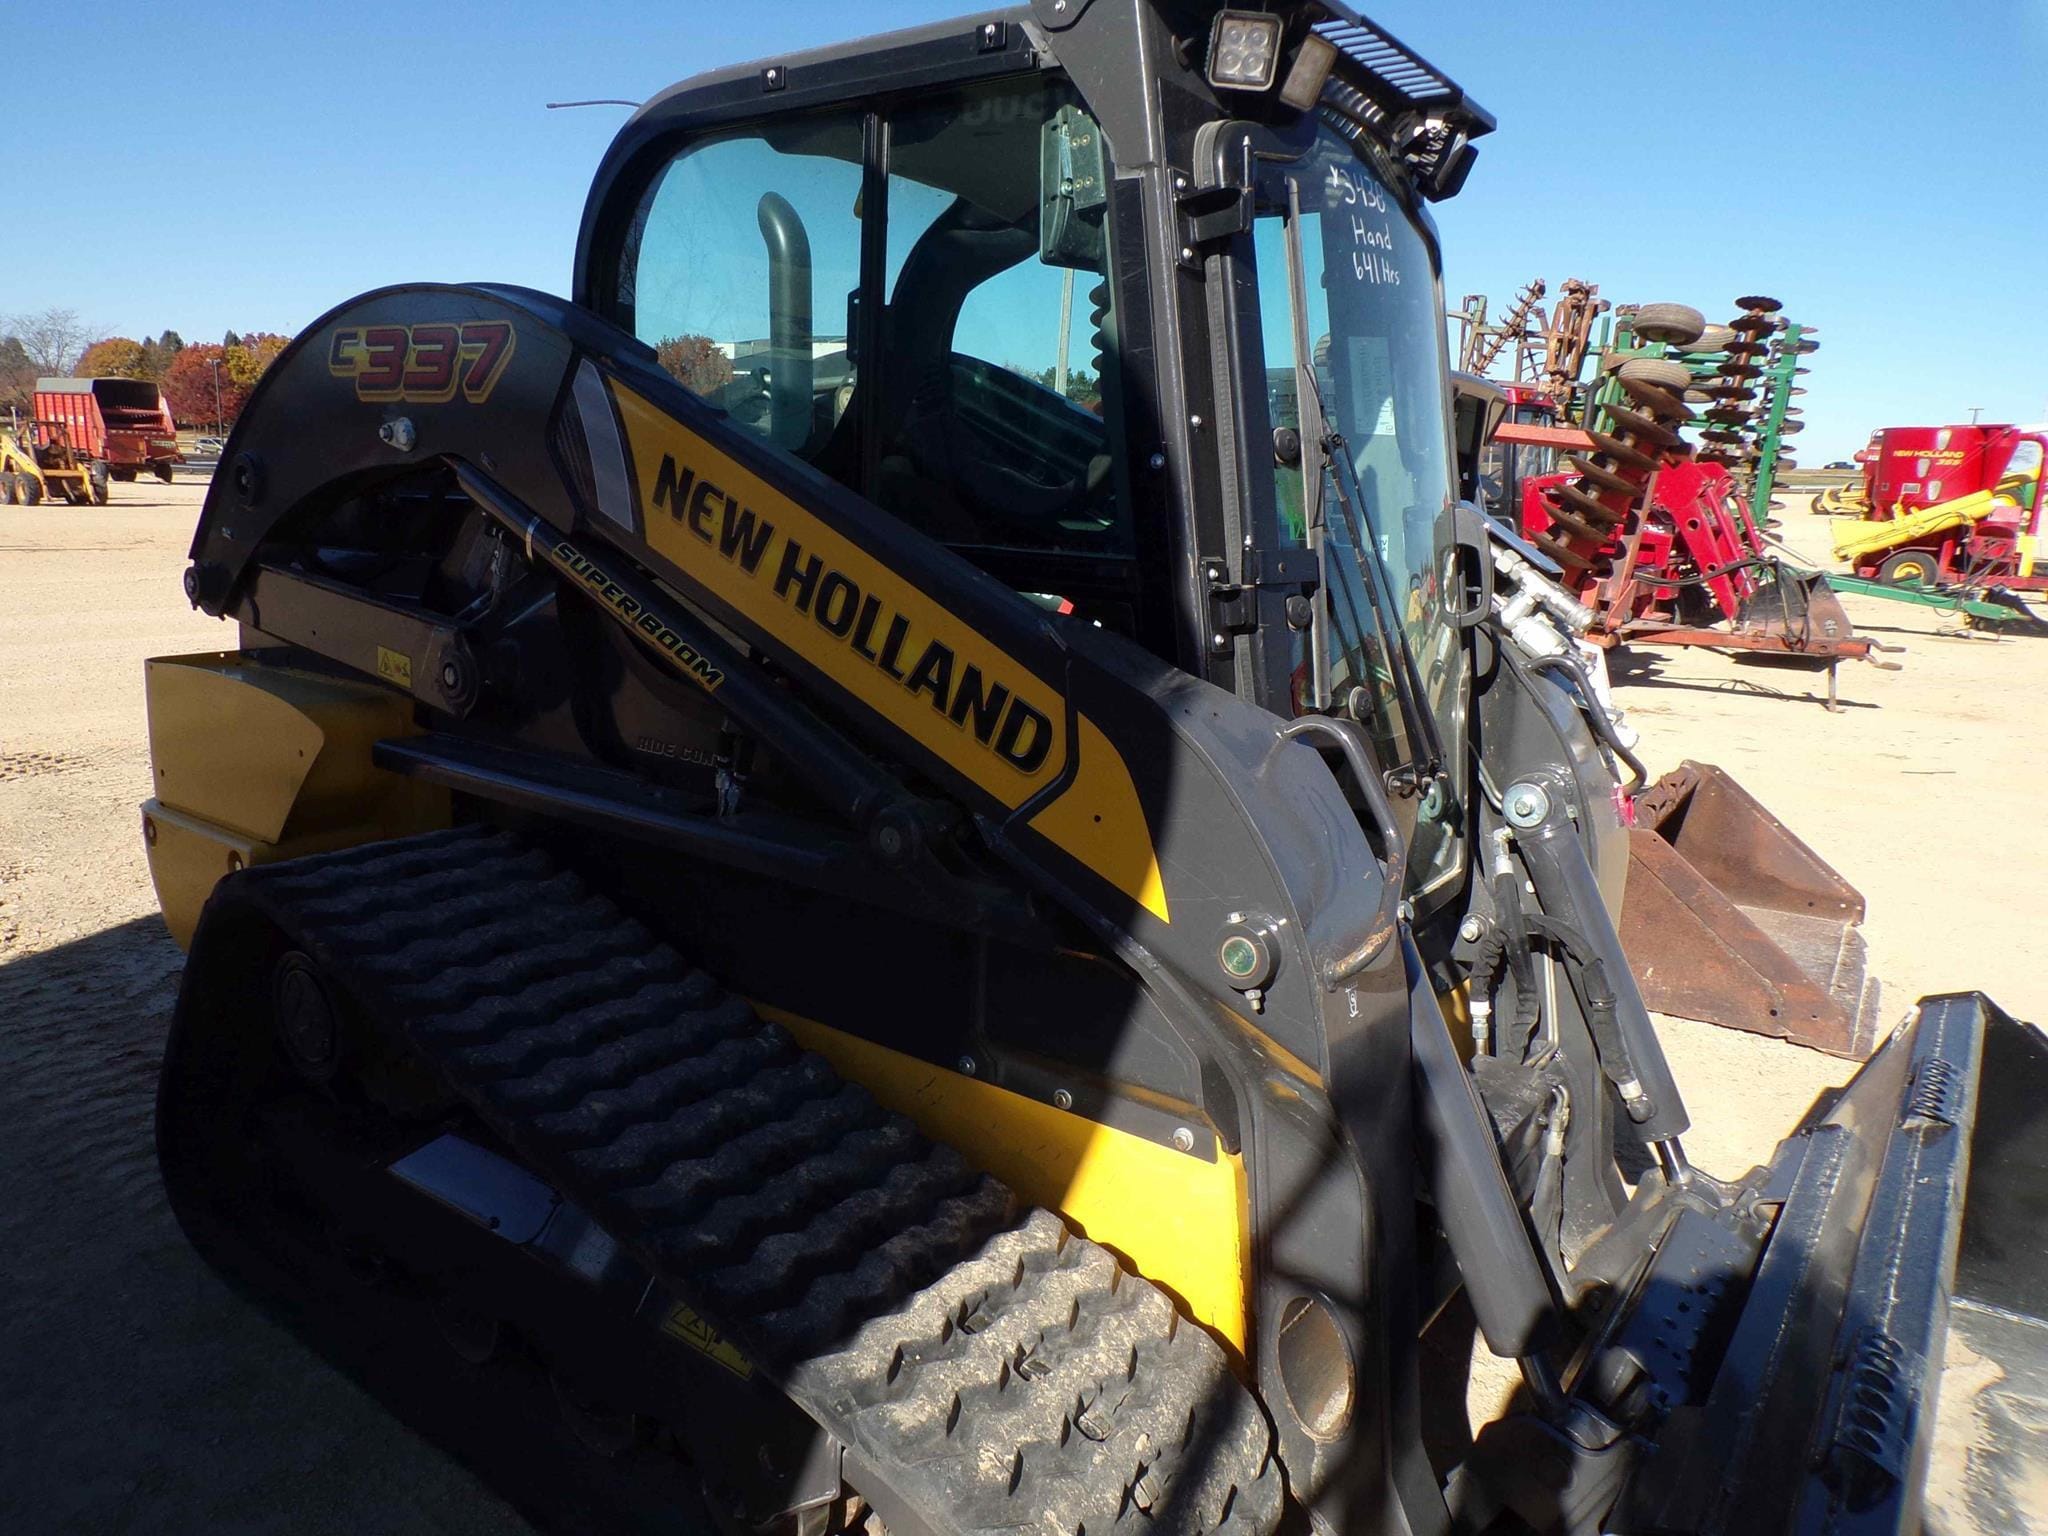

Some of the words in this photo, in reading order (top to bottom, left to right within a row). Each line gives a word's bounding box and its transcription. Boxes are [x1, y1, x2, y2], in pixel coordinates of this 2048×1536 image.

[1351, 213, 1393, 251] Hand
[1352, 251, 1380, 284] 641
[1381, 256, 1400, 286] Hrs
[329, 320, 517, 404] C337
[652, 452, 776, 576] NEW
[772, 536, 1056, 776] HOLLAND
